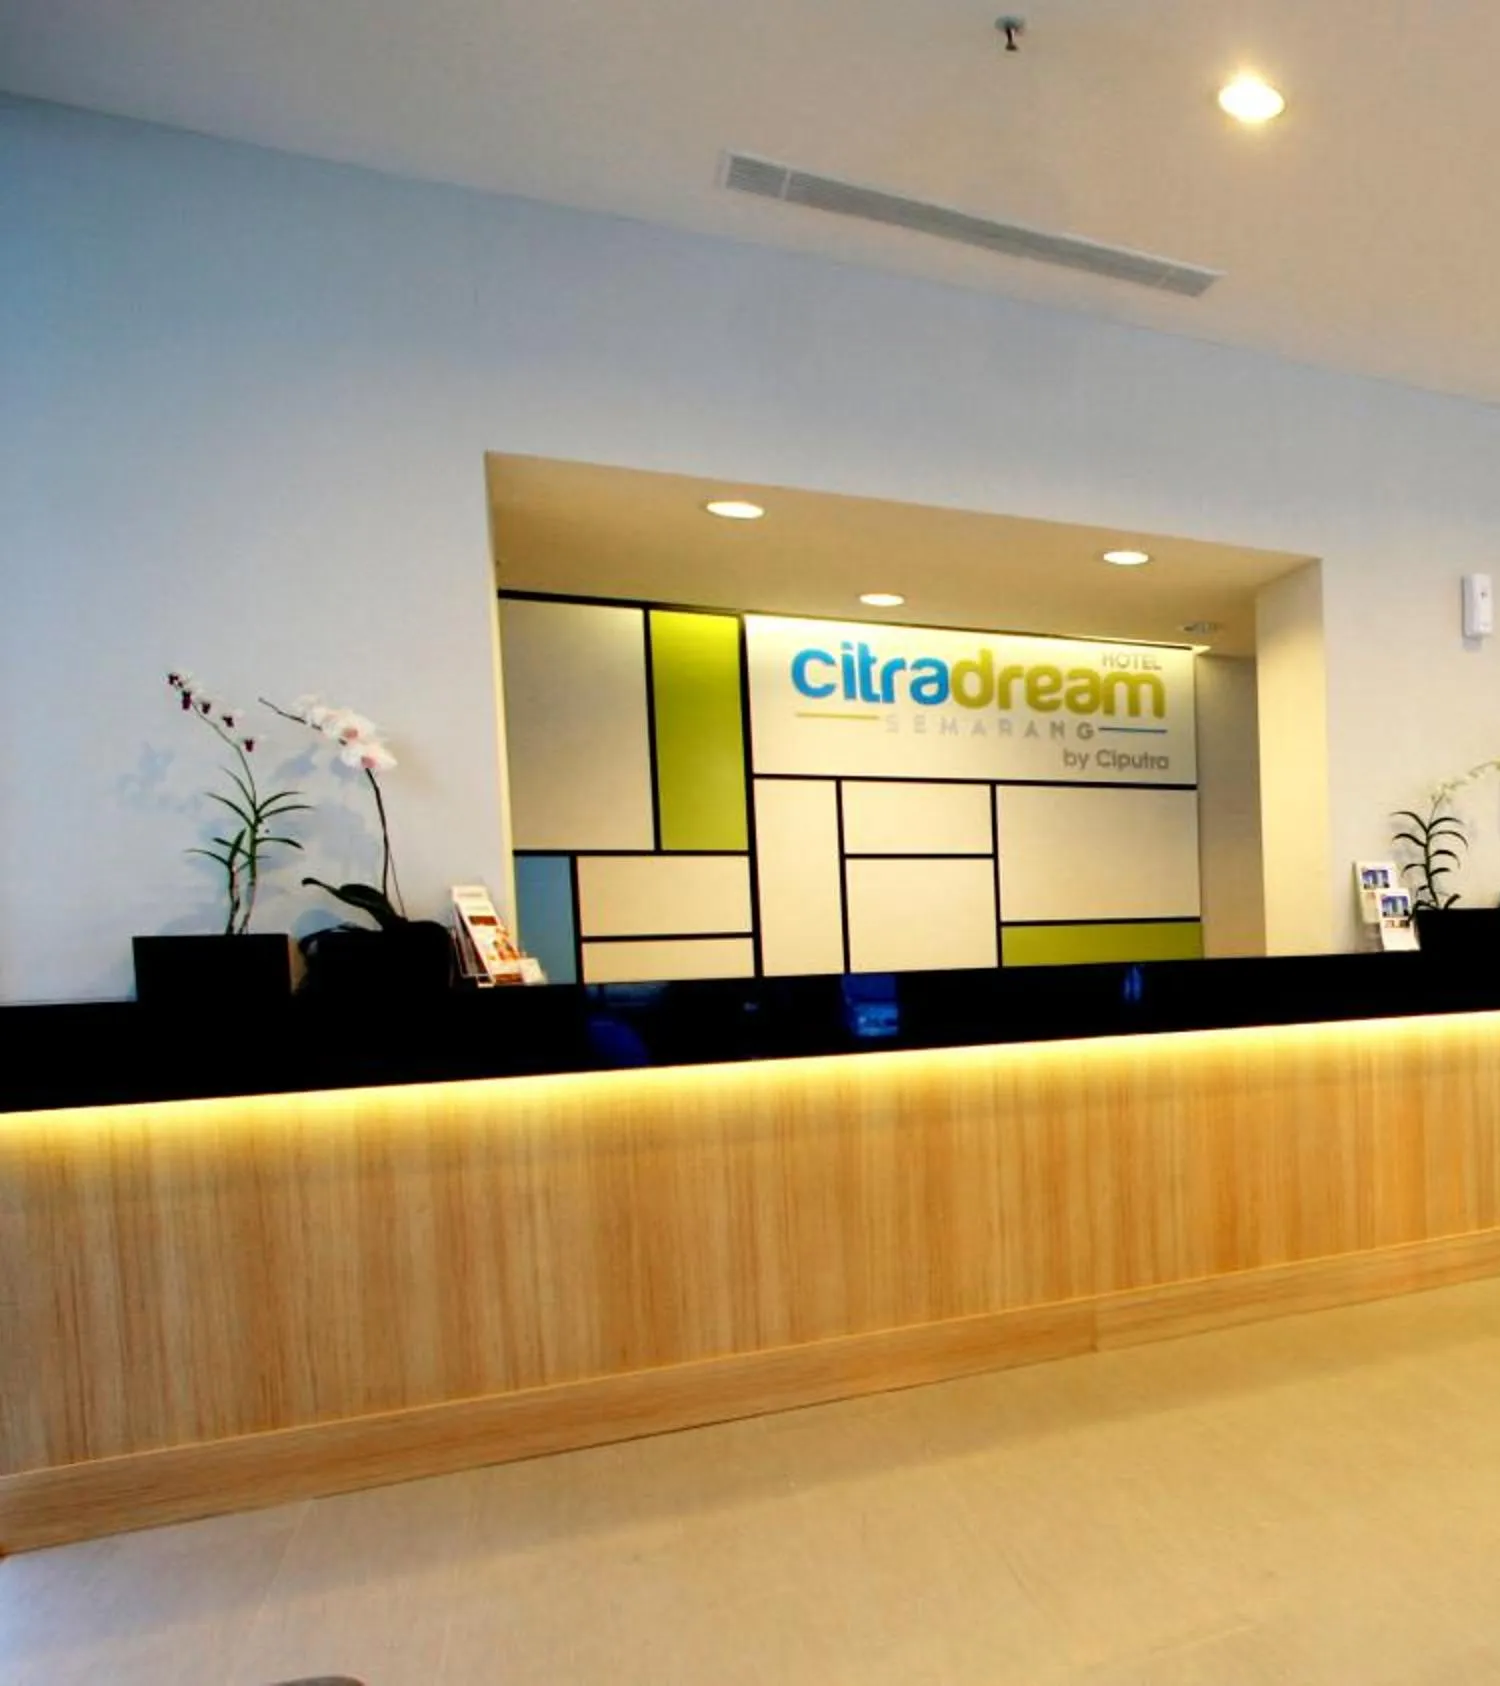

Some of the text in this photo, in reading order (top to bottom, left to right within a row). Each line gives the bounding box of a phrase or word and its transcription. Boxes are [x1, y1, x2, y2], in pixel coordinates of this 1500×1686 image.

[1101, 653, 1163, 672] HOTEL
[790, 640, 1167, 720] citradream
[885, 716, 1095, 741] SEMARANG
[1062, 747, 1170, 772] by Ciputra
